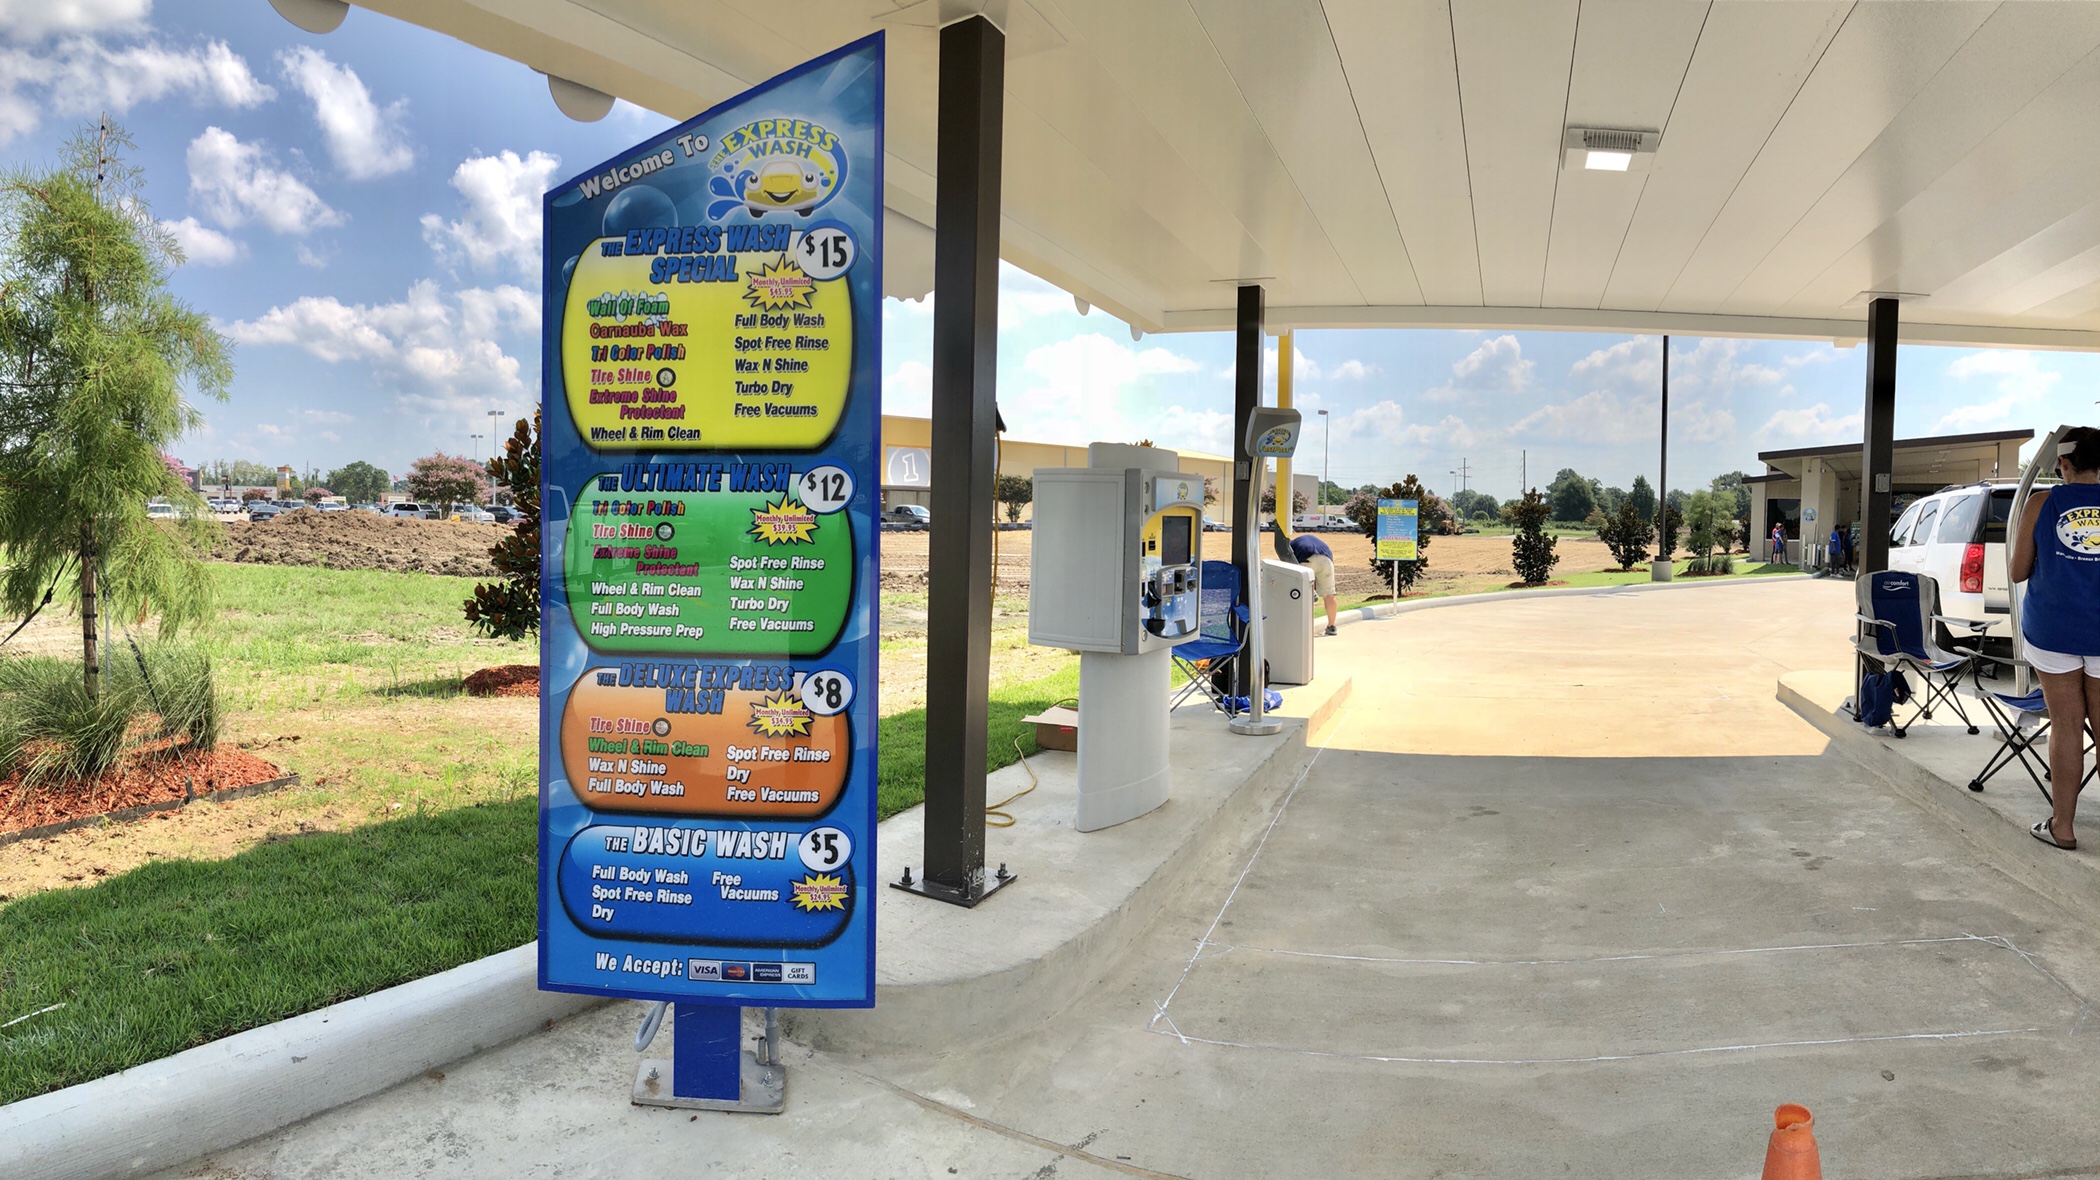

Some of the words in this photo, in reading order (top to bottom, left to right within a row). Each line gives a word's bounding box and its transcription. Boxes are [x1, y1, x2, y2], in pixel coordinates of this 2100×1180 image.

[708, 148, 729, 171] THE
[719, 118, 840, 155] EXPRESS
[748, 140, 813, 159] WASH
[579, 148, 674, 200] Welcome
[678, 133, 709, 157] To
[601, 241, 623, 257] THE
[623, 226, 722, 255] EXPRESS
[727, 224, 791, 252] WASH
[649, 255, 738, 284] SPECIAL
[753, 278, 778, 287] Monthly
[780, 277, 811, 285] Unlimited
[769, 288, 793, 296] $45.95
[589, 300, 616, 317] Wall
[618, 299, 635, 315] Of
[635, 299, 670, 315] Foam
[590, 322, 655, 339] Carnauba
[658, 321, 688, 337] Wax
[734, 314, 757, 328] Full
[760, 314, 791, 331] Body
[792, 314, 825, 328] Wash
[591, 346, 608, 361] Tri
[610, 345, 644, 361] Color
[646, 343, 686, 360] Polish
[734, 337, 763, 353] Spot
[764, 336, 792, 350] Free
[794, 336, 829, 350] Rinse
[734, 358, 761, 373] Wax
[762, 359, 772, 372] N
[774, 358, 809, 372] Shine
[590, 369, 614, 385] Tire
[617, 368, 652, 384] Shine
[589, 389, 639, 405] Extreme
[642, 388, 677, 403] Shine
[735, 381, 768, 395] Turbo
[771, 381, 793, 397] Dry
[620, 405, 686, 420] Protectant
[734, 403, 762, 417] Free
[764, 403, 818, 417] Vacuums
[590, 427, 627, 441] Wheel
[629, 426, 639, 440] &
[641, 426, 664, 440] Rim
[667, 426, 701, 440] Clean
[902, 452, 919, 483] 1
[598, 477, 618, 491] THE
[620, 464, 723, 492] ULTIMATE
[728, 463, 791, 492] WASH
[592, 501, 607, 515] Tri
[611, 501, 643, 515] Color
[646, 501, 685, 516] Polish
[756, 514, 781, 522] Monthly
[783, 514, 814, 522] Unlimited
[593, 524, 615, 538] Tire
[619, 524, 654, 539] Shine
[773, 524, 797, 532] $39.95
[593, 545, 640, 559] Extreme
[643, 545, 677, 559] Shine
[635, 562, 699, 577] Protectant
[729, 556, 758, 571] Spot
[760, 556, 788, 570] Free
[790, 556, 825, 570] Rinse
[591, 582, 627, 596] Wheel
[630, 582, 639, 595] &
[641, 582, 665, 596] Rim
[668, 582, 701, 597] Clean
[729, 577, 756, 590] Wax
[757, 577, 767, 590] N
[769, 577, 804, 591] Shine
[591, 603, 613, 616] Full
[615, 603, 644, 618] Body
[648, 604, 680, 617] Wash
[729, 597, 764, 611] Turbo
[767, 597, 790, 613] Dry
[591, 622, 617, 637] High
[619, 623, 672, 637] Pressure
[675, 624, 703, 640] Prep
[729, 618, 757, 631] Free
[759, 618, 815, 632] Vacuums
[597, 673, 617, 686] THE
[618, 663, 698, 689] DELUXE
[699, 665, 794, 691] EXPRESS
[665, 690, 725, 715] WASH
[590, 717, 613, 733] Tire
[616, 718, 650, 733] Shine
[588, 738, 628, 755] Wheel
[630, 740, 640, 753] &
[642, 740, 668, 755] Rim
[671, 741, 709, 758] Clean
[727, 746, 757, 762] Spot
[760, 747, 790, 761] Free
[793, 747, 830, 762] Rinse
[588, 758, 616, 772] Wax
[617, 759, 628, 773] N
[630, 759, 667, 775] Shine
[726, 767, 750, 783] Dry
[588, 778, 612, 793] Full
[614, 779, 647, 796] Body
[650, 781, 685, 797] Wash
[726, 787, 756, 801] Free
[760, 787, 819, 803] Vacuums
[605, 836, 628, 852] THE
[632, 826, 707, 857] BASIC
[716, 829, 788, 860] WASH
[592, 866, 615, 881] Full
[619, 867, 651, 885] Body
[654, 869, 689, 885] Wash
[711, 871, 742, 886] Free
[591, 885, 621, 902] Spot
[624, 887, 653, 902] Free
[656, 889, 692, 905] Rinse
[720, 886, 779, 902] Vacuums
[591, 904, 614, 922] Dry
[595, 952, 617, 971] We
[622, 955, 684, 978] Accept:
[693, 965, 718, 975] VISA
